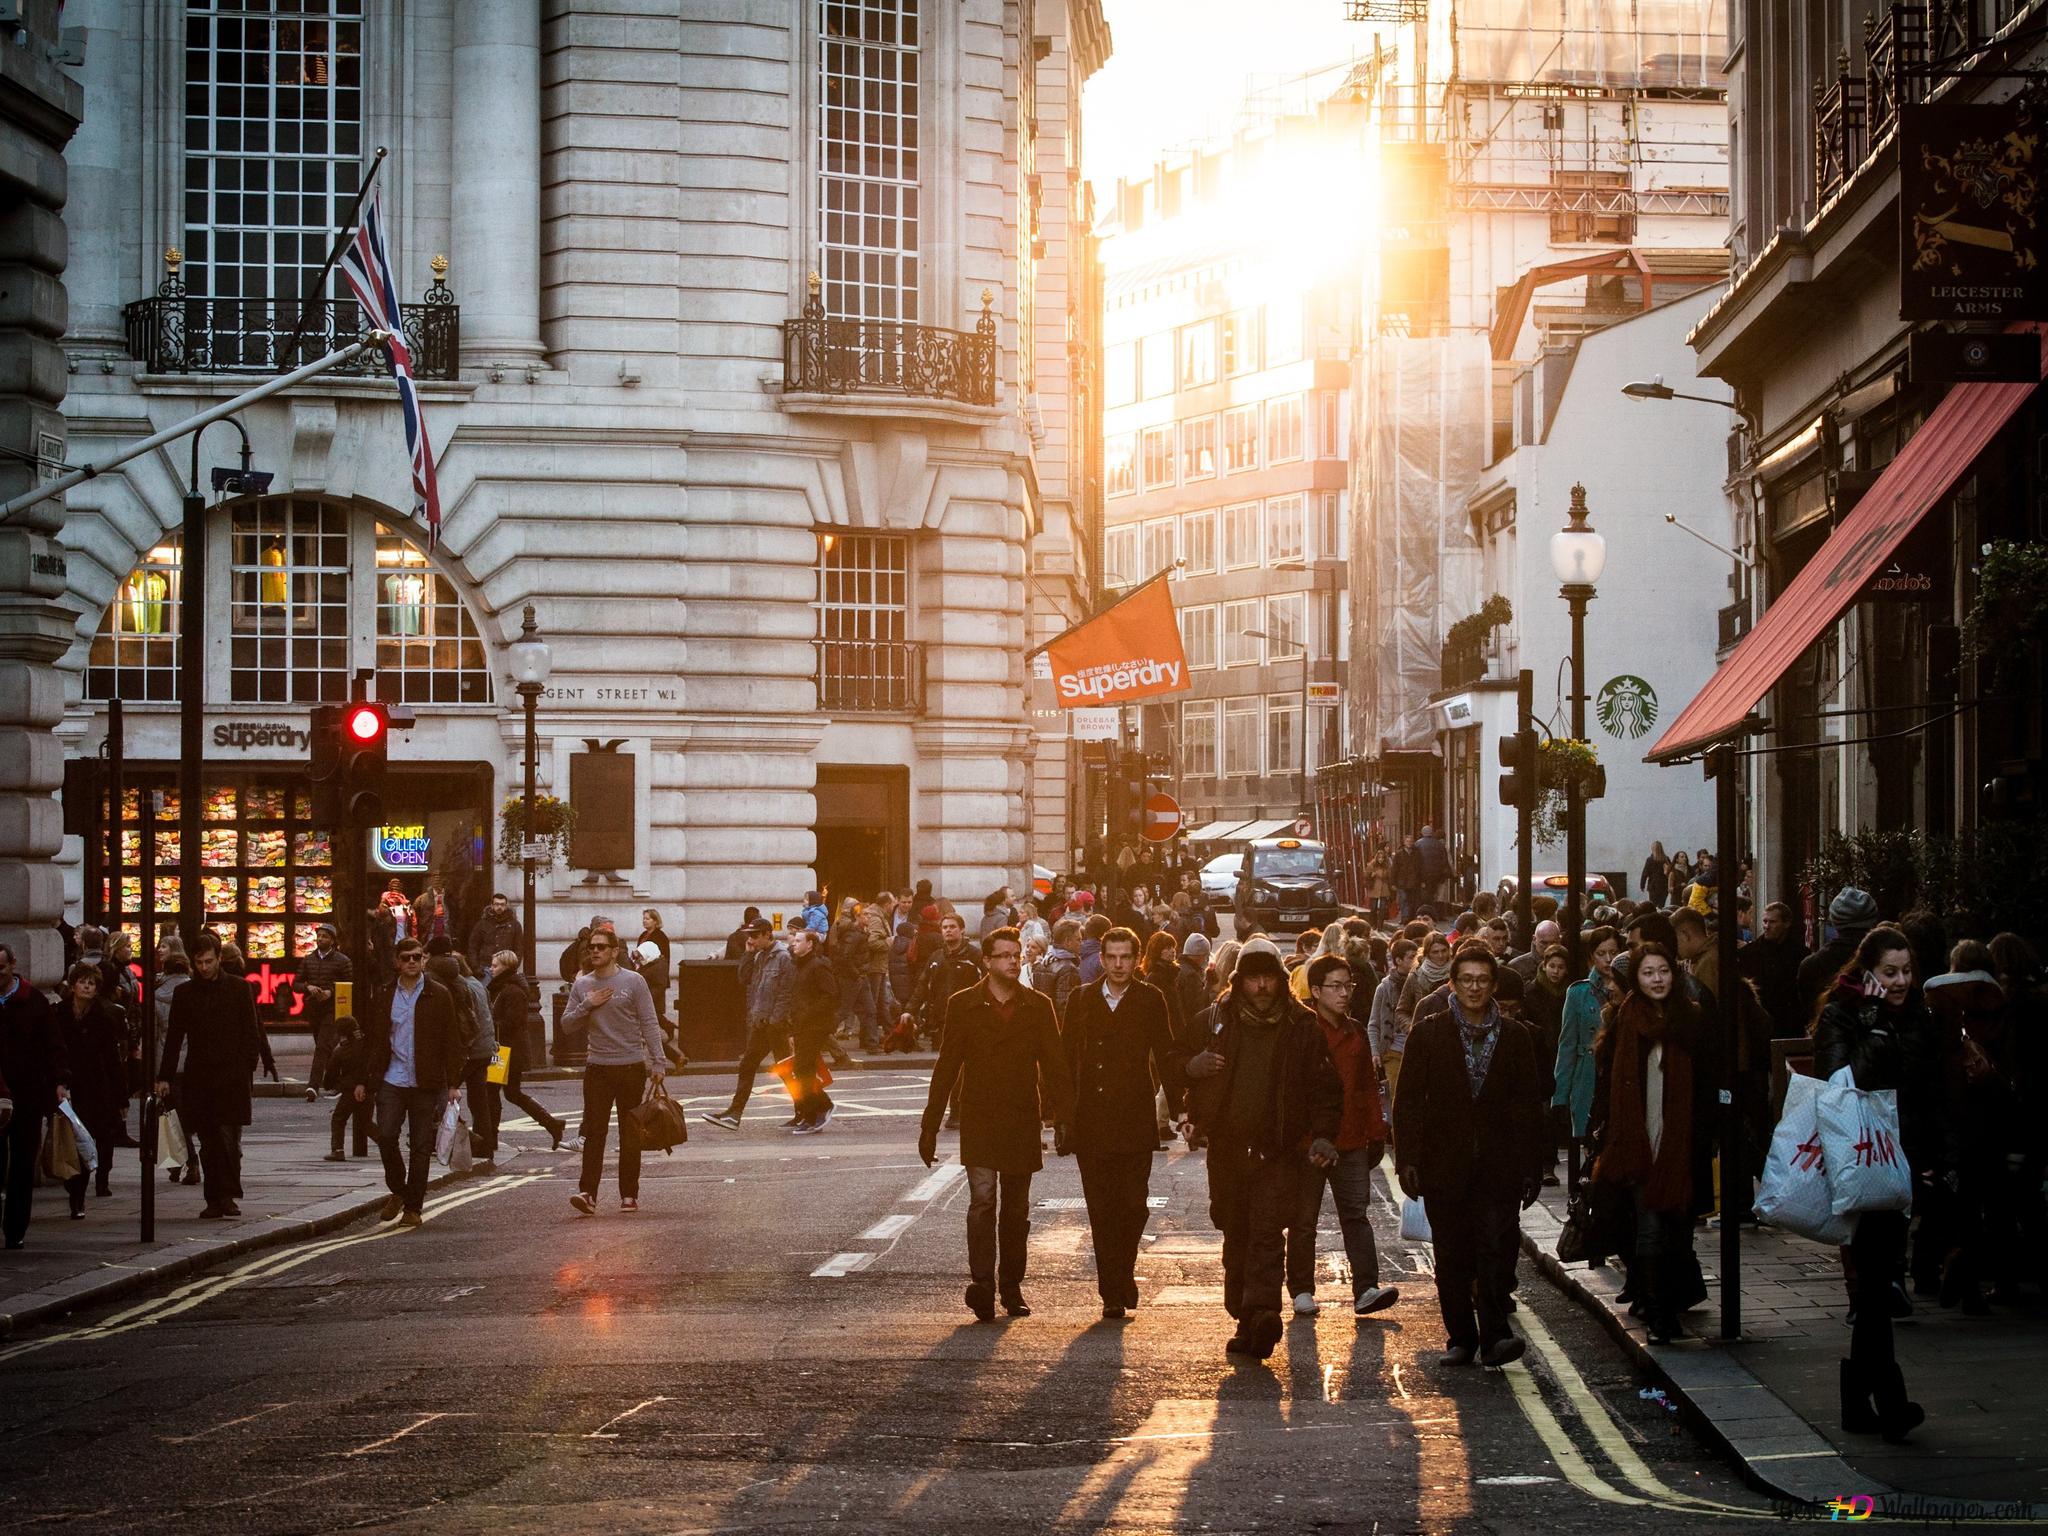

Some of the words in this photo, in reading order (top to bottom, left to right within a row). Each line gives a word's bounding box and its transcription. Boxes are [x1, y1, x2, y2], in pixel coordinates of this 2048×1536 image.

[1930, 286, 2024, 298] LEICESTER
[1953, 302, 2003, 314] ARMS
[1059, 659, 1181, 699] Superdry
[538, 688, 585, 700] GENT
[597, 689, 648, 700] STREET
[1076, 716, 1116, 724] ORLEBAR
[213, 724, 311, 752] Superdry
[382, 826, 425, 840] T-SHIRT
[384, 838, 431, 852] GALLERY
[1852, 1126, 1899, 1170] H&M
